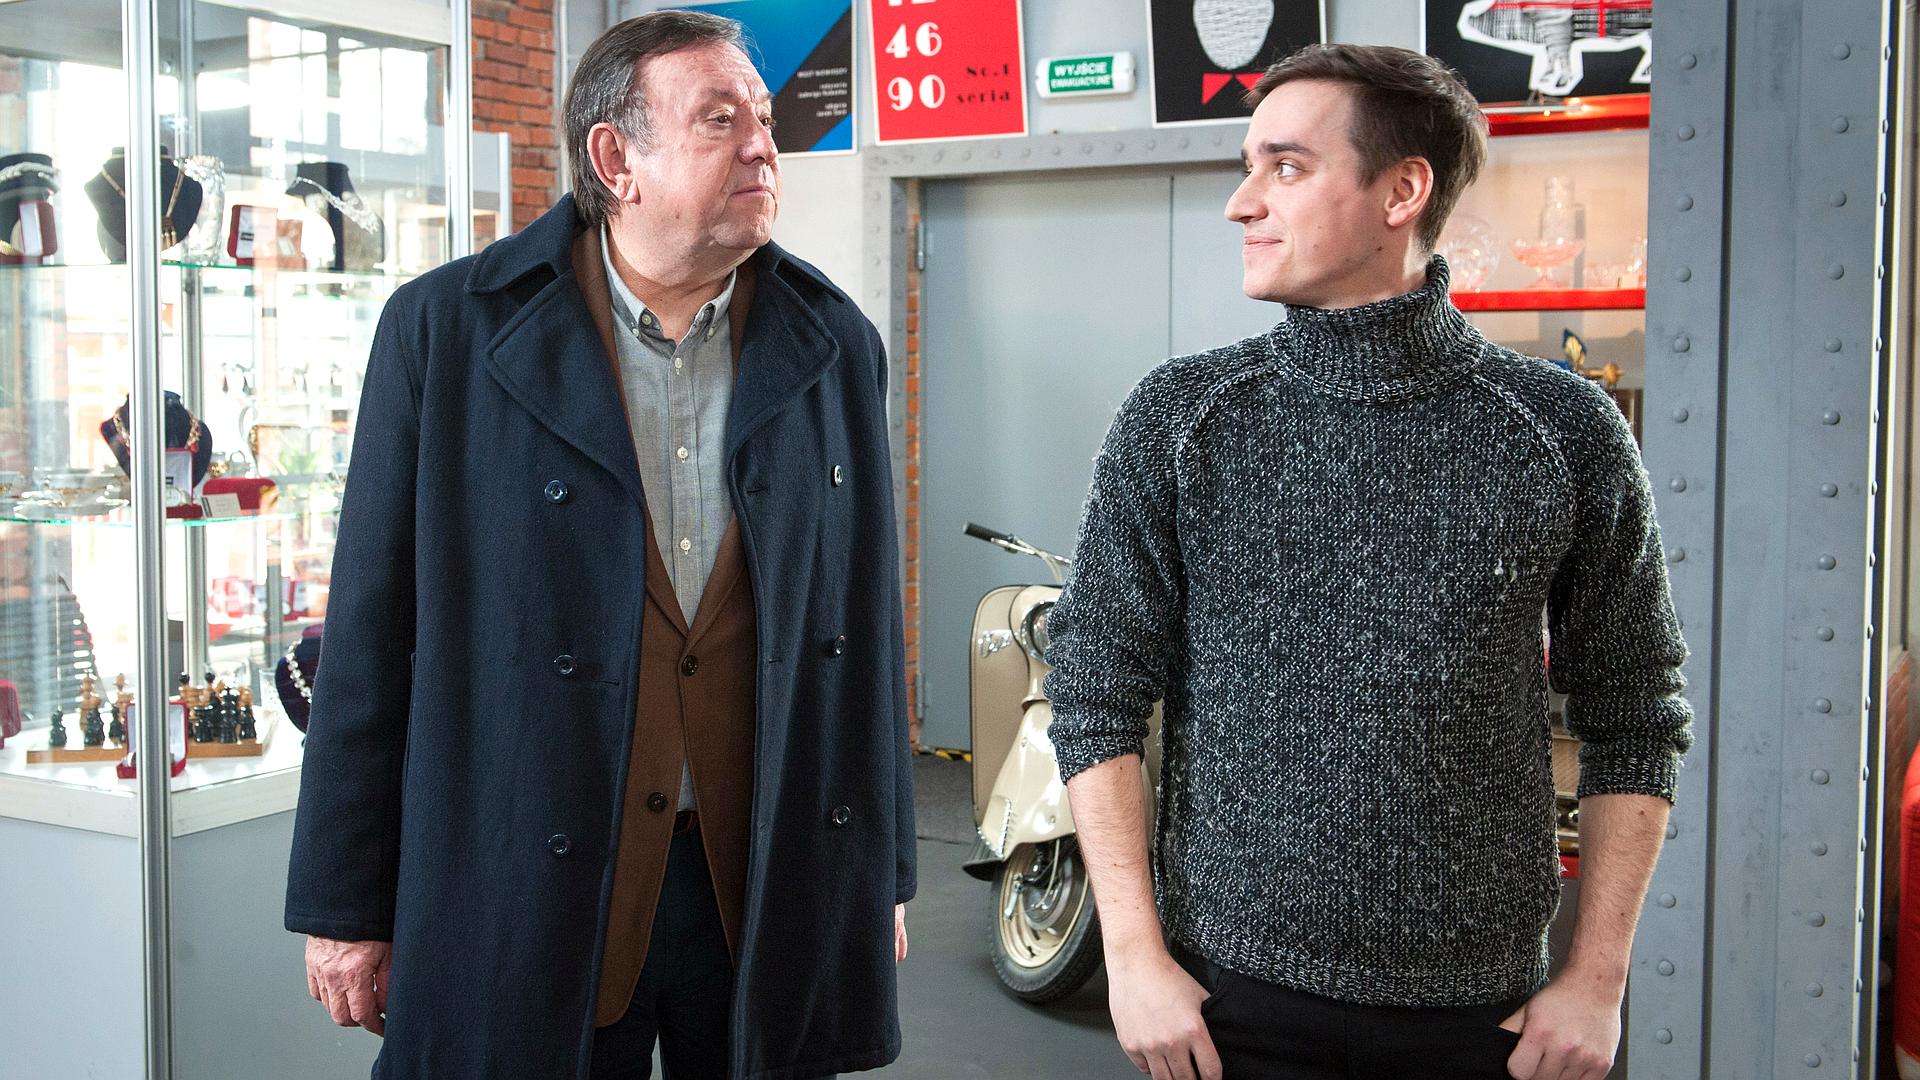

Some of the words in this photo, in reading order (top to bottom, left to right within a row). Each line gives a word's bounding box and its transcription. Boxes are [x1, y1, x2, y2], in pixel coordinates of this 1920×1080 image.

[885, 21, 943, 59] 46
[1054, 61, 1107, 77] WYJŚCIE
[887, 74, 946, 112] 90
